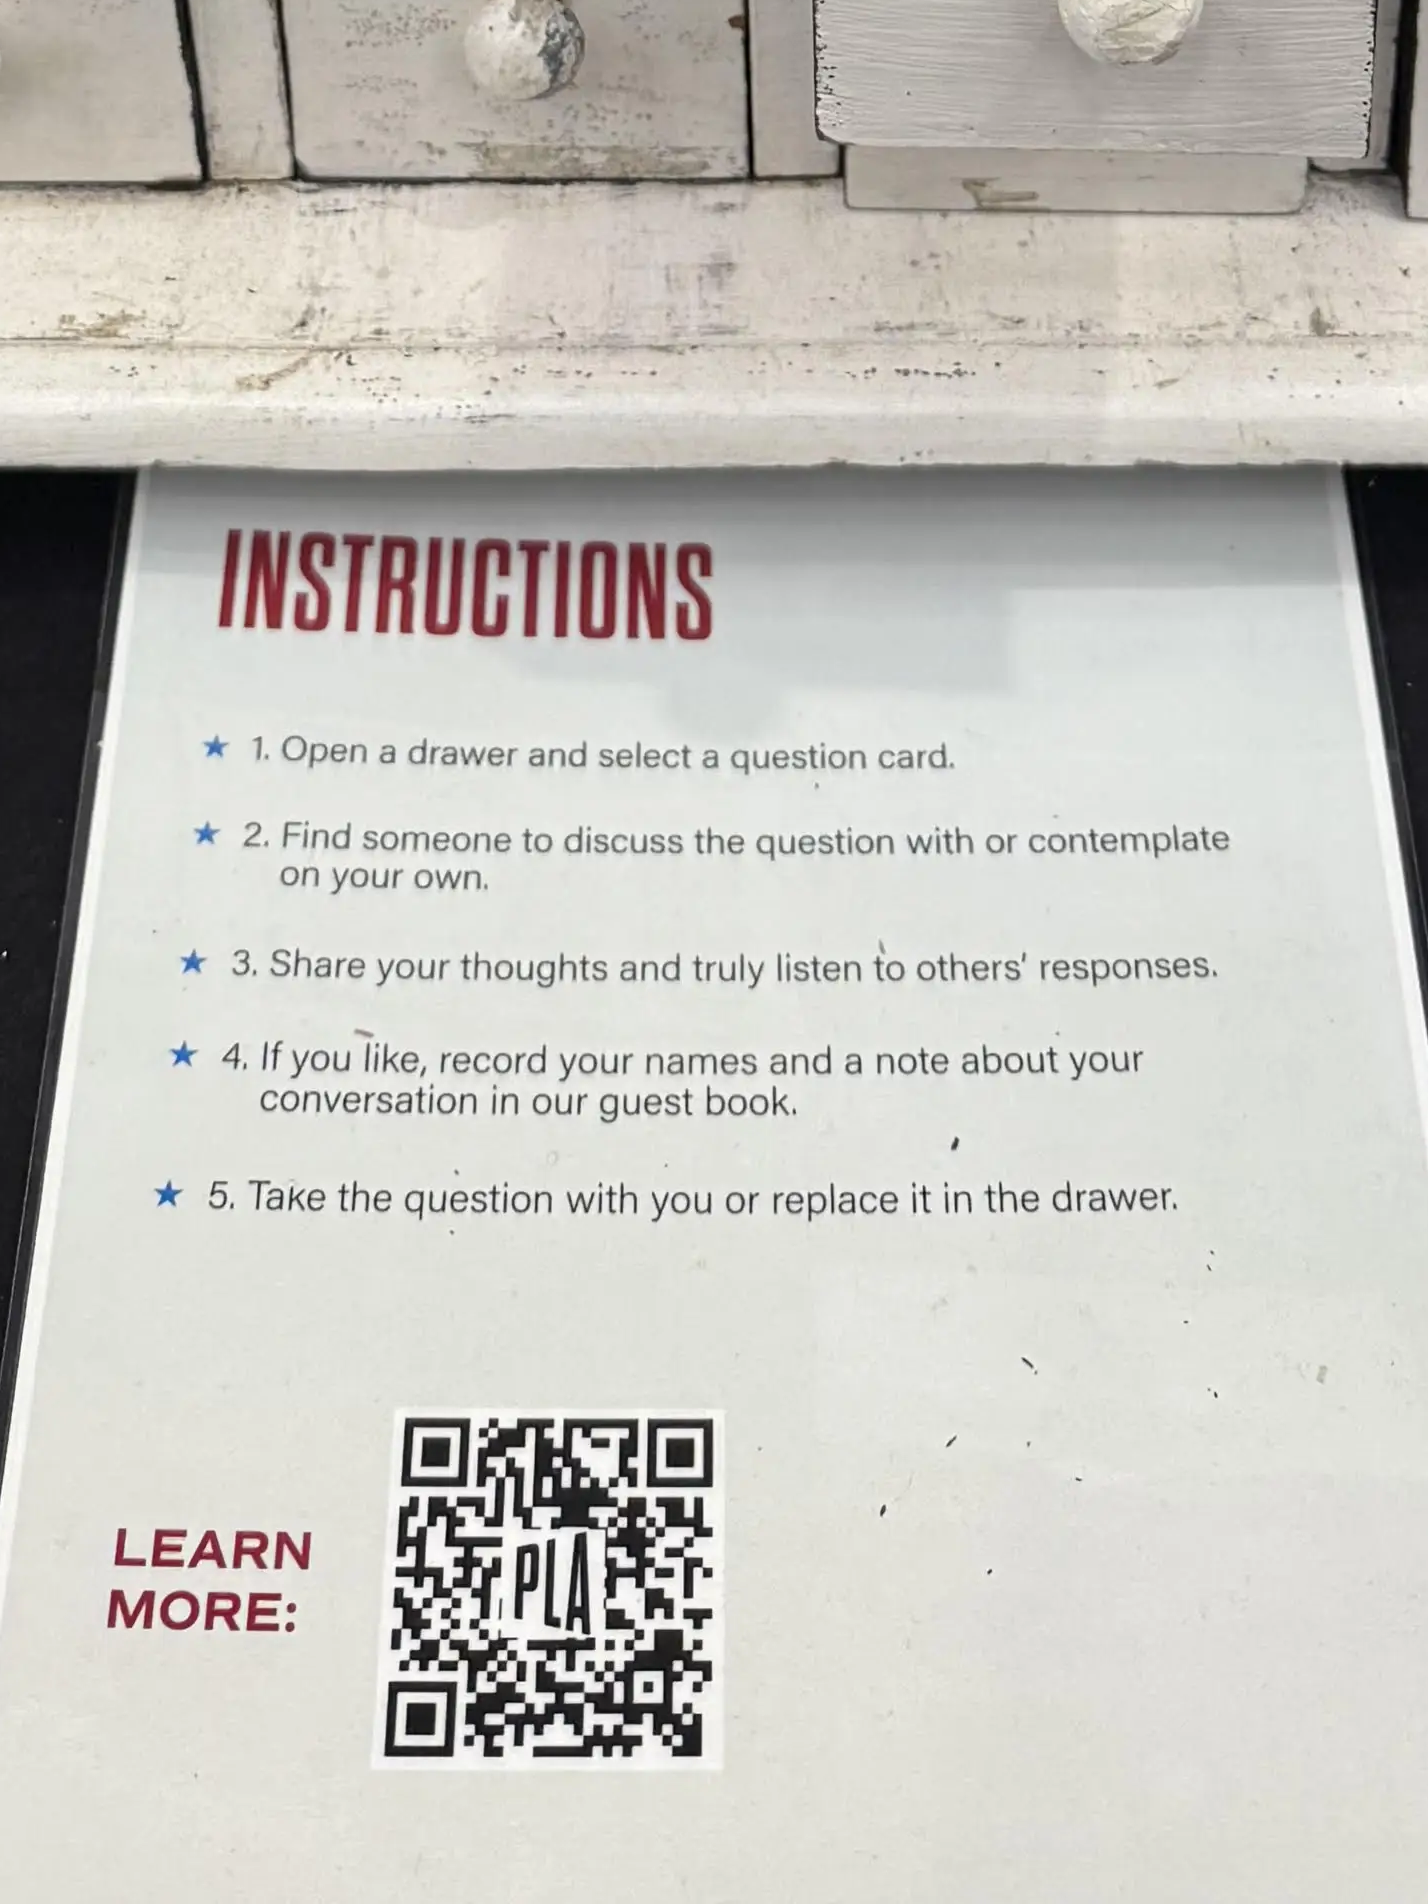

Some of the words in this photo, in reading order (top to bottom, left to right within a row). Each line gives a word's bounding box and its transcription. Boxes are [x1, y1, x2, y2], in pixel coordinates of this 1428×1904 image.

[217, 527, 713, 642] INSTRUCTIONS
[251, 735, 270, 761] 1.
[281, 734, 368, 769] Open
[378, 744, 397, 765] a
[407, 737, 519, 768] drawer
[528, 740, 588, 768] and
[598, 741, 692, 770] select
[702, 749, 720, 770] a
[730, 742, 867, 776] question
[877, 742, 955, 770] card.
[243, 821, 270, 849] 2.
[282, 820, 352, 850] Find
[362, 830, 512, 853] someone
[521, 828, 554, 854] to
[563, 825, 684, 855] discuss
[693, 826, 745, 856] the
[755, 826, 895, 862] question
[906, 826, 975, 856] with
[985, 833, 1018, 855] or
[1028, 824, 1231, 860] contemplate
[279, 865, 320, 888] on
[330, 867, 404, 896] your
[413, 868, 489, 891] own.
[231, 948, 258, 977] 3.
[269, 947, 366, 980] Share
[375, 958, 451, 988] your
[459, 951, 608, 989] thoughts
[619, 952, 681, 983] and
[692, 952, 765, 991] truly
[776, 952, 862, 983] listen
[872, 955, 906, 983] to
[916, 951, 1027, 982] others'
[1039, 956, 1218, 988] responses.
[221, 1042, 248, 1071] 4.
[261, 1039, 284, 1072] If
[289, 1049, 351, 1080] you
[364, 1041, 427, 1078] like,
[439, 1043, 547, 1075] record
[558, 1052, 634, 1083] your
[645, 1052, 758, 1076] names
[769, 1044, 832, 1076] and
[844, 1052, 863, 1076] a
[876, 1046, 950, 1076] note
[961, 1043, 1060, 1075] about
[1068, 1050, 1144, 1082] your
[259, 1083, 478, 1116] conversation
[491, 1083, 519, 1116] in
[532, 1093, 589, 1116] our
[599, 1088, 693, 1125] guest
[705, 1084, 797, 1117] book.
[208, 1180, 235, 1211] 5.
[247, 1179, 327, 1213] Take
[337, 1179, 393, 1213] the
[404, 1181, 553, 1222] question
[566, 1181, 638, 1215] with
[651, 1191, 713, 1224] you
[725, 1191, 760, 1215] or
[773, 1182, 899, 1223] replace
[911, 1181, 932, 1215] it
[943, 1181, 973, 1215] in
[983, 1180, 1040, 1214] the
[1052, 1179, 1178, 1213] drawer.
[113, 1528, 312, 1570] LEARN
[515, 1530, 592, 1636] PLA
[106, 1589, 298, 1633] MORE:
